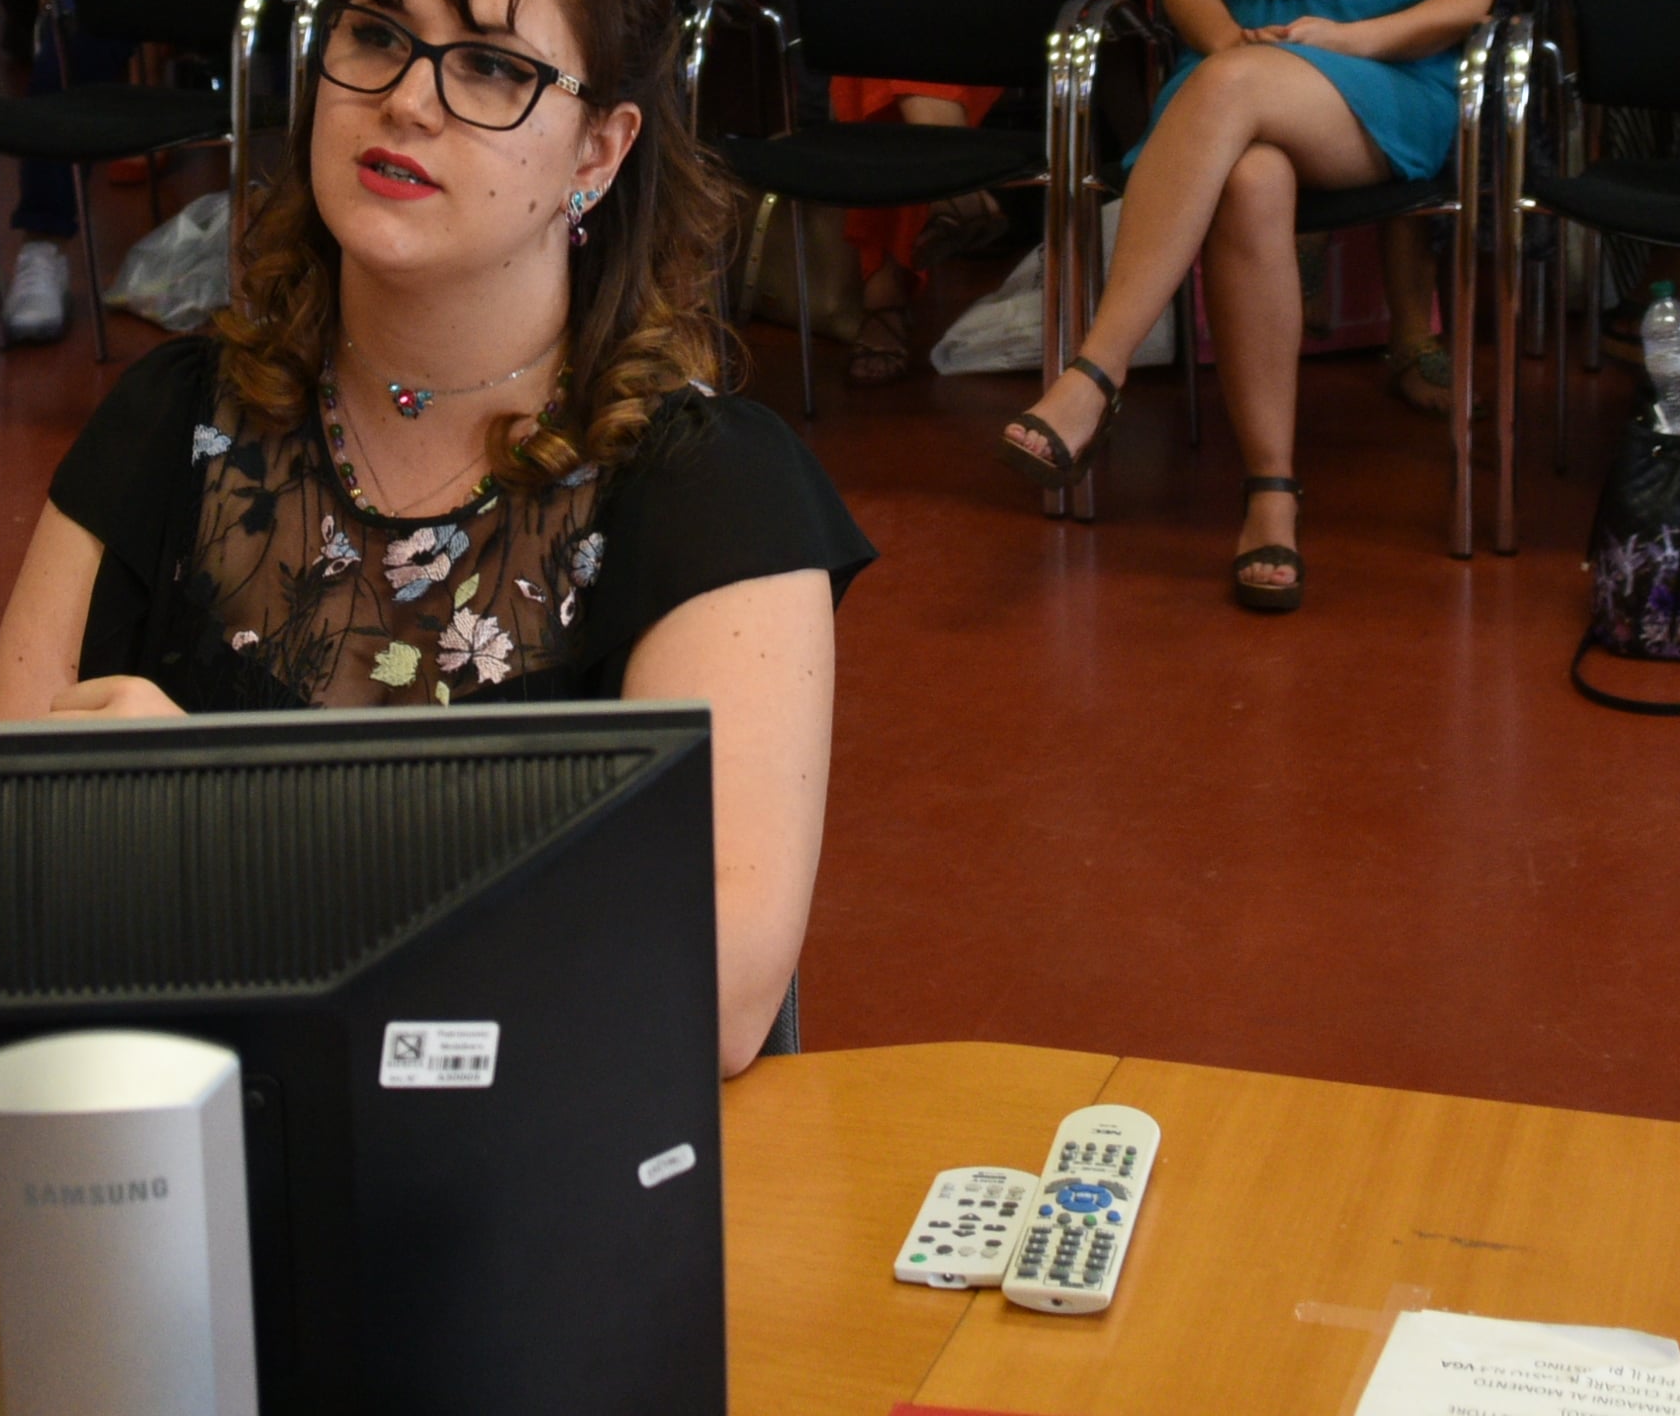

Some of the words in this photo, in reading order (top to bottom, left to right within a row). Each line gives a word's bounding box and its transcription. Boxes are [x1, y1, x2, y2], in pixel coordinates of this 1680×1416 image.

[23, 1176, 170, 1206] SAMSUNG
[1440, 1361, 1475, 1373] VGA
[1473, 1378, 1564, 1398] MOMENTO
[1586, 1377, 1661, 1399] CLICCARE
[1647, 1374, 1677, 1388] PER
